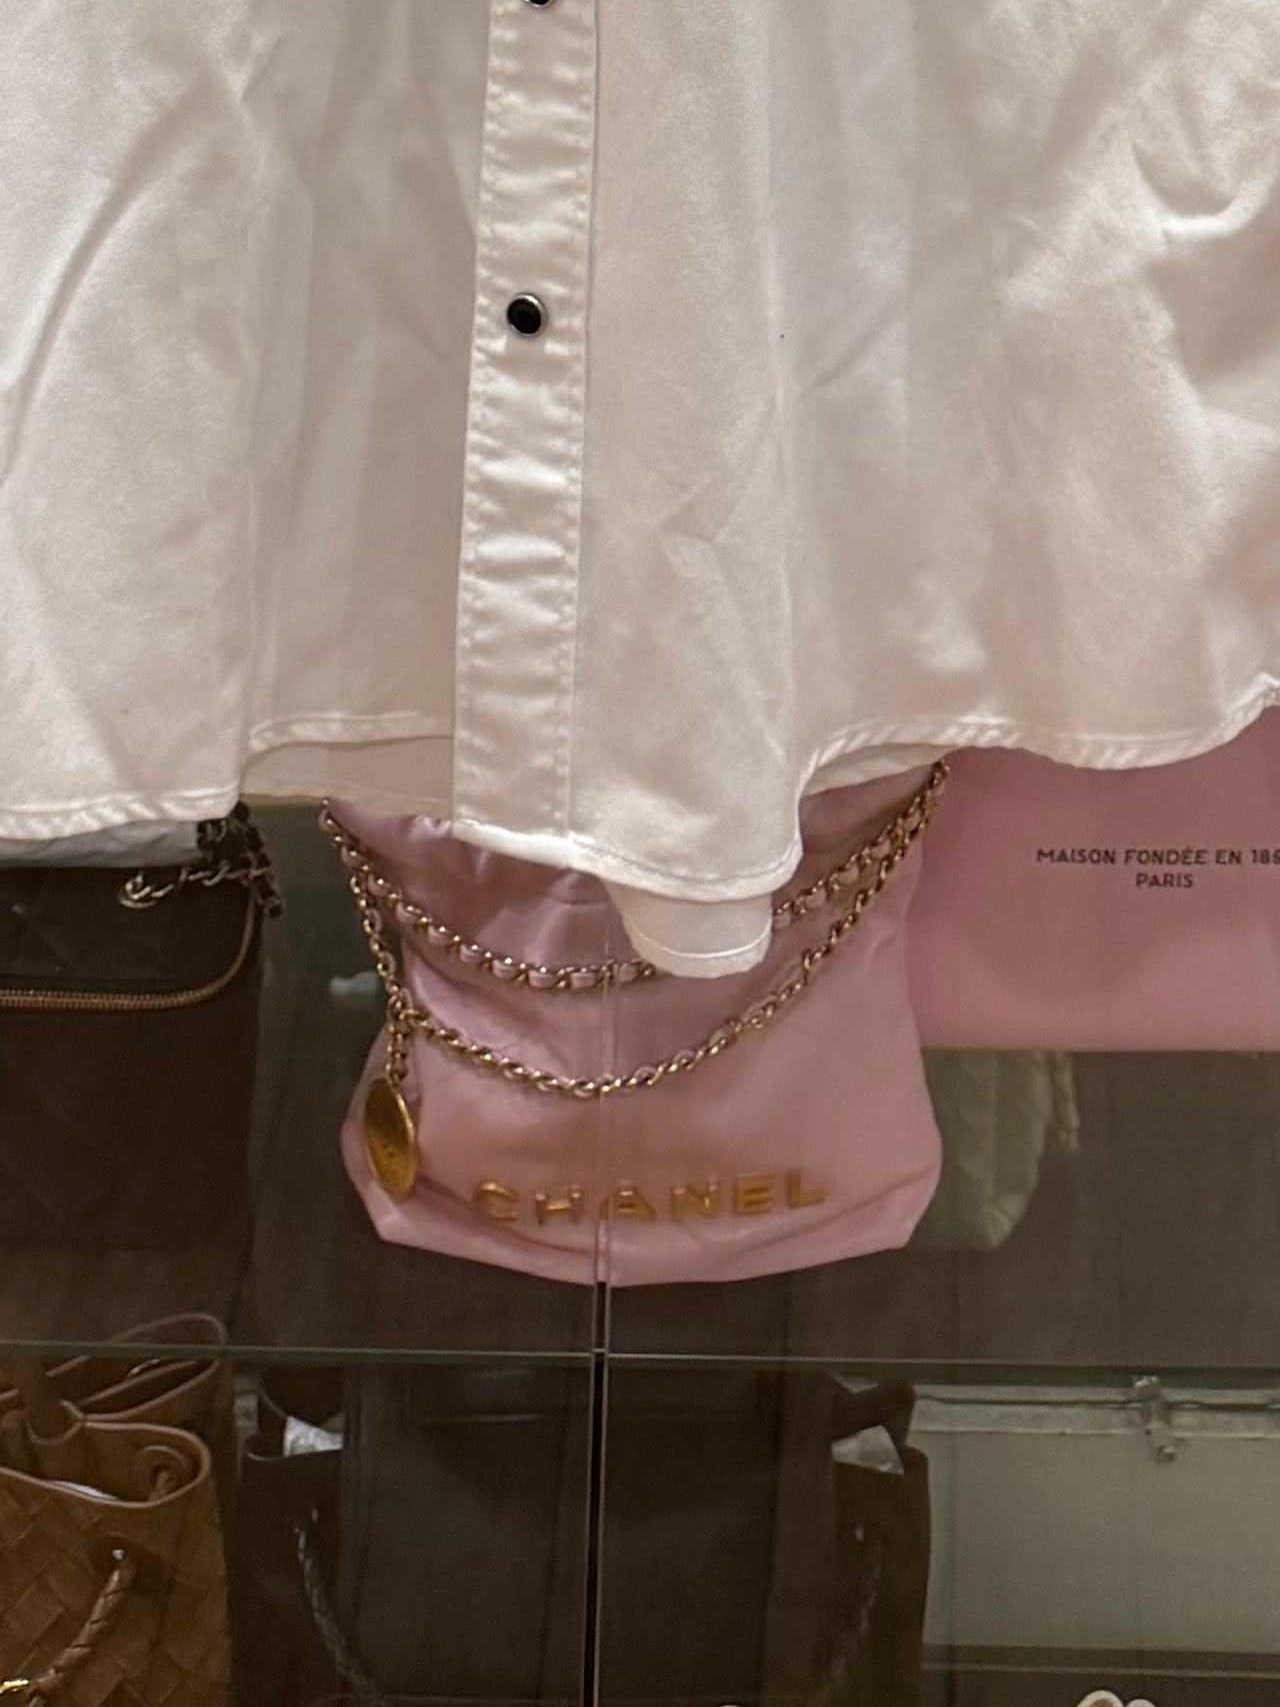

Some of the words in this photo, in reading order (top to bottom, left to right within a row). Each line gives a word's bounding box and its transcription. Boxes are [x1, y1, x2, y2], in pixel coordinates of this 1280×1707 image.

[1035, 847, 1117, 864] MAISON
[1123, 846, 1208, 865] FONDÉE
[1214, 848, 1242, 865] EN
[1135, 871, 1194, 889] PARIS
[470, 1166, 827, 1226] CHANEL
